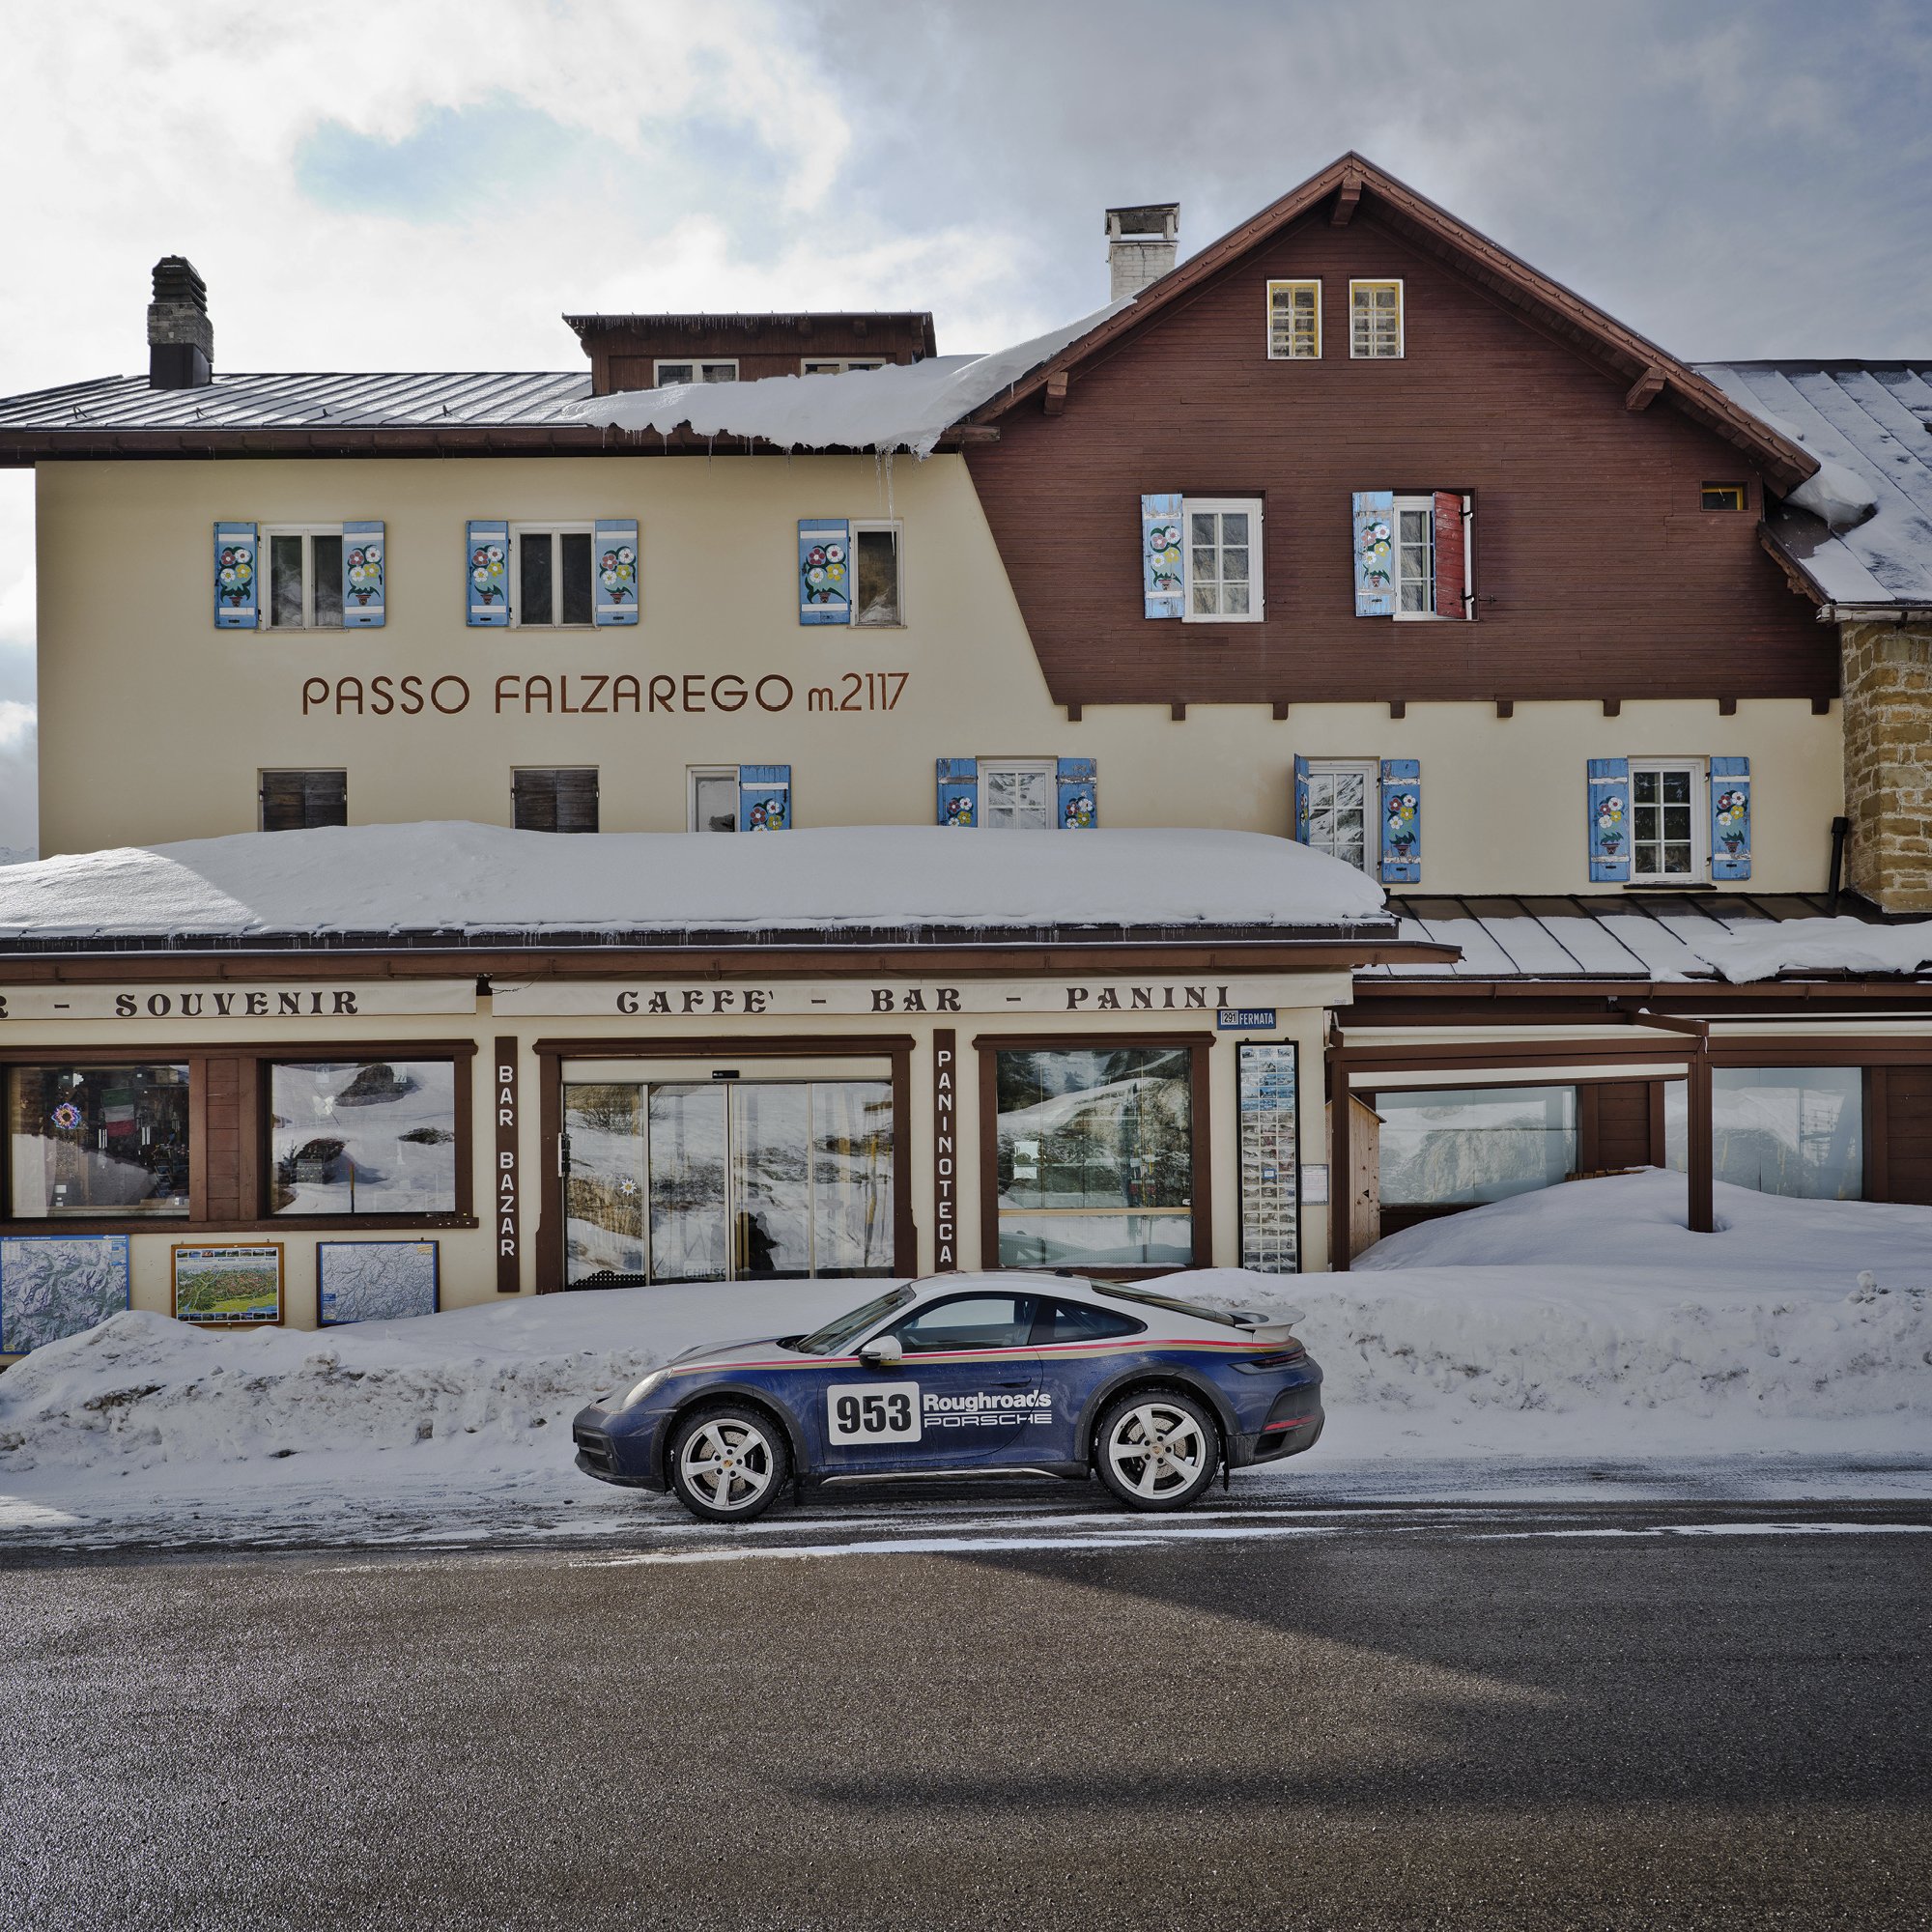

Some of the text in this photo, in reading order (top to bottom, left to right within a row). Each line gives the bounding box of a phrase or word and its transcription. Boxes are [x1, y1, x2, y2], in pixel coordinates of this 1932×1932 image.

[302, 674, 471, 716] PASSO
[495, 673, 795, 714] FALZAREGO
[115, 990, 358, 1017] SOUVENIR
[870, 987, 962, 1012] BAR
[1065, 985, 1230, 1010] PANINI
[1223, 1012, 1274, 1025] 291 FERMATA
[498, 1065, 515, 1257] BAR BAZAR
[938, 1050, 953, 1263] PANINOTECA
[837, 1393, 912, 1435] 953
[923, 1389, 1052, 1412] Roughroads
[923, 1413, 1053, 1429] PORSCHE
